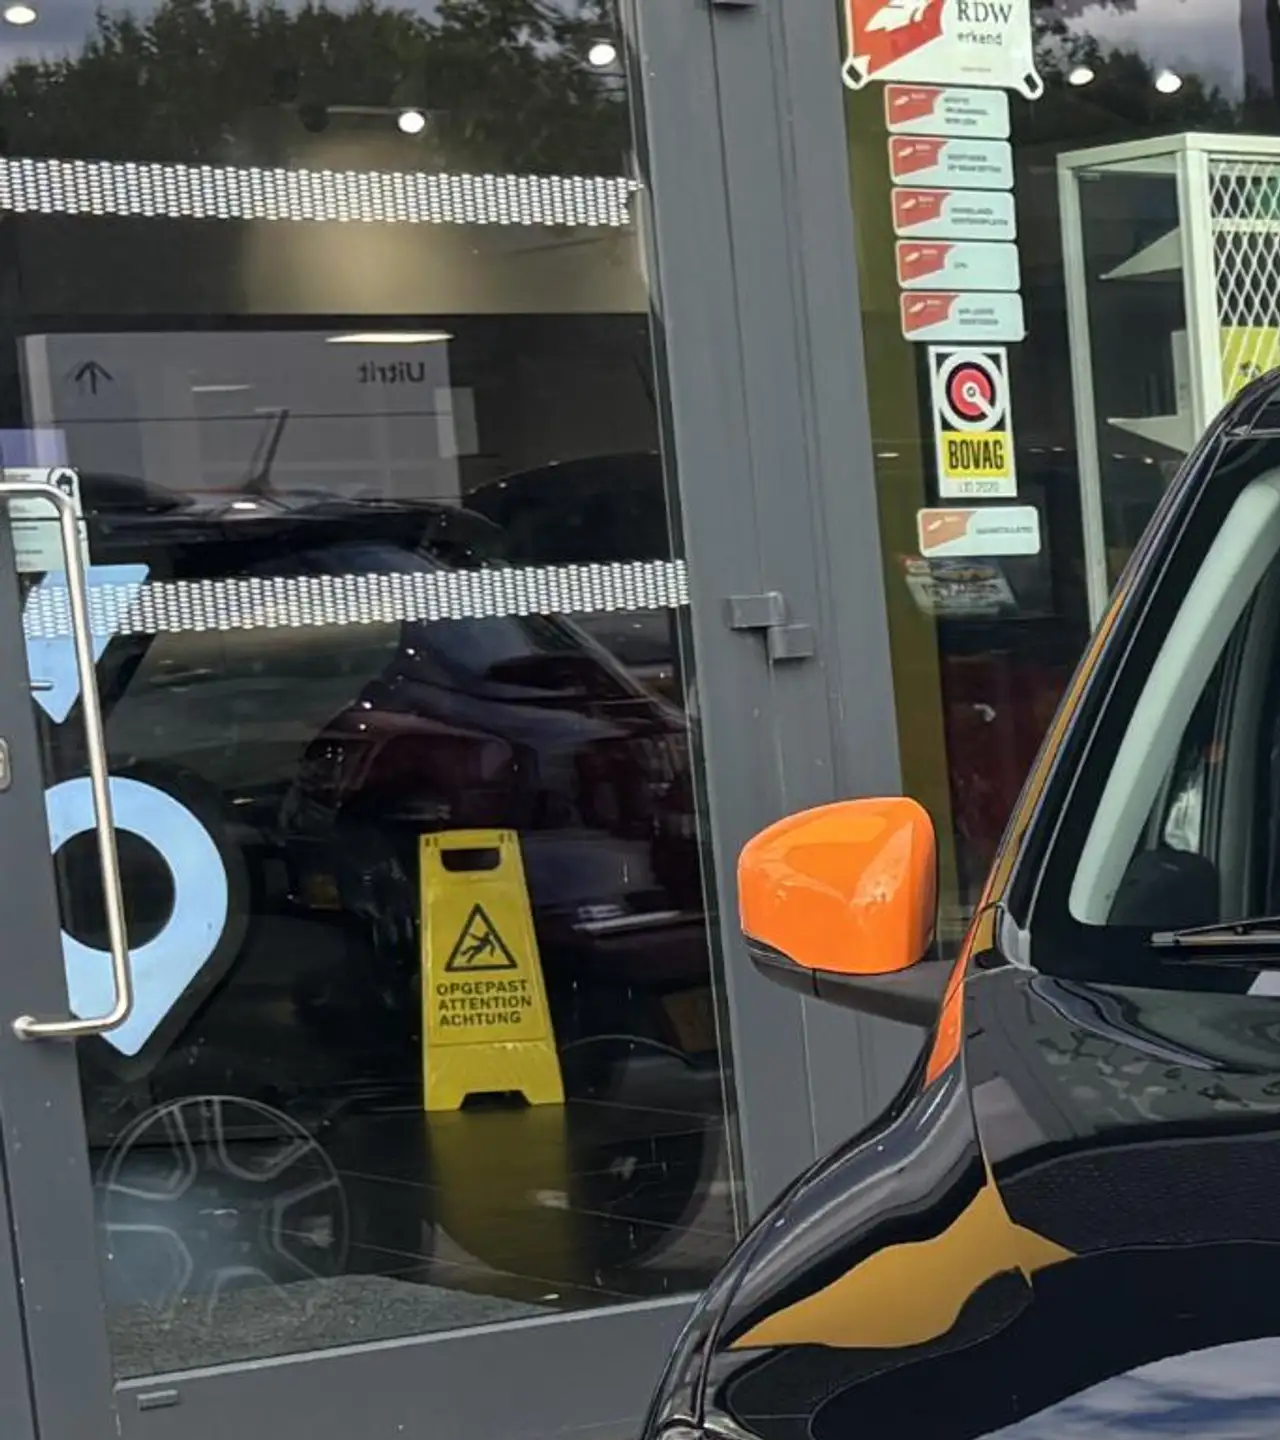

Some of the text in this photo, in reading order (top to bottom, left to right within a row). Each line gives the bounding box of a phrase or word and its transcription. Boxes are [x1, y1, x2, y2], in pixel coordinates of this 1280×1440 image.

[957, 0, 1012, 23] RDW
[947, 439, 1005, 470] BOVAG
[436, 979, 528, 997] OPGEPAST
[438, 995, 533, 1012] ATTENTION
[438, 1010, 522, 1027] ACHTUNG
